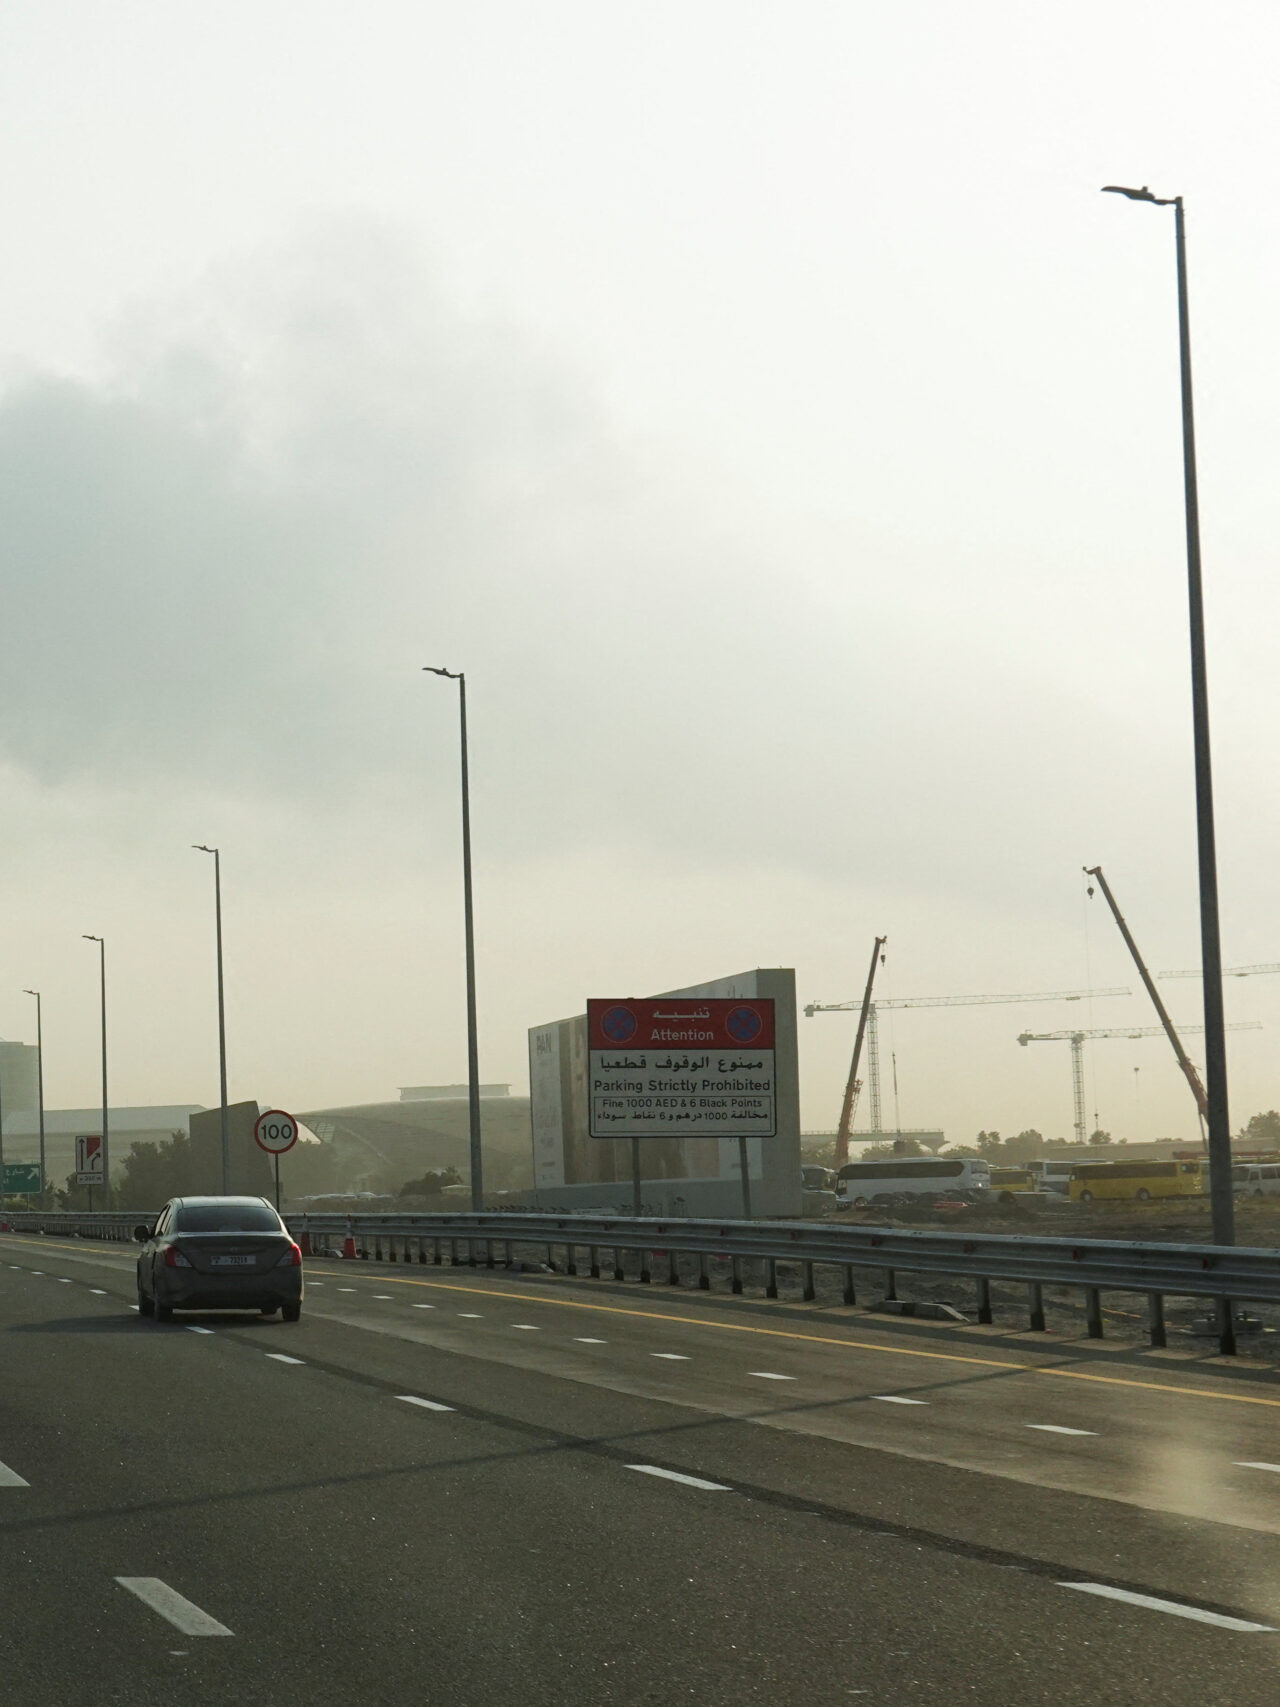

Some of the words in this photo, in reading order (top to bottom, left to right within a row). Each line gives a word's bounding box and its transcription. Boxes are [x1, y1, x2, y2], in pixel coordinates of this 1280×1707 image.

[652, 1006, 710, 1021] تنبيه
[651, 1029, 714, 1041] Attention
[600, 1055, 647, 1073] قطعيا
[655, 1055, 710, 1073] الوقوف
[717, 1056, 764, 1073] ممنوع
[594, 1079, 643, 1093] Parking
[648, 1079, 698, 1093] Strictly
[702, 1079, 771, 1092] Prohibited
[602, 1098, 624, 1108] Fine
[627, 1098, 652, 1108] 1000
[655, 1098, 678, 1108] AED
[680, 1098, 687, 1108] &
[689, 1098, 697, 1108] 6
[699, 1098, 728, 1108] Black
[731, 1098, 762, 1108] Points
[659, 1111, 666, 1120] 6
[676, 1111, 703, 1121] درهم
[704, 1111, 728, 1120] 1000
[730, 1110, 768, 1120] مخالفة
[261, 1123, 293, 1140] 100
